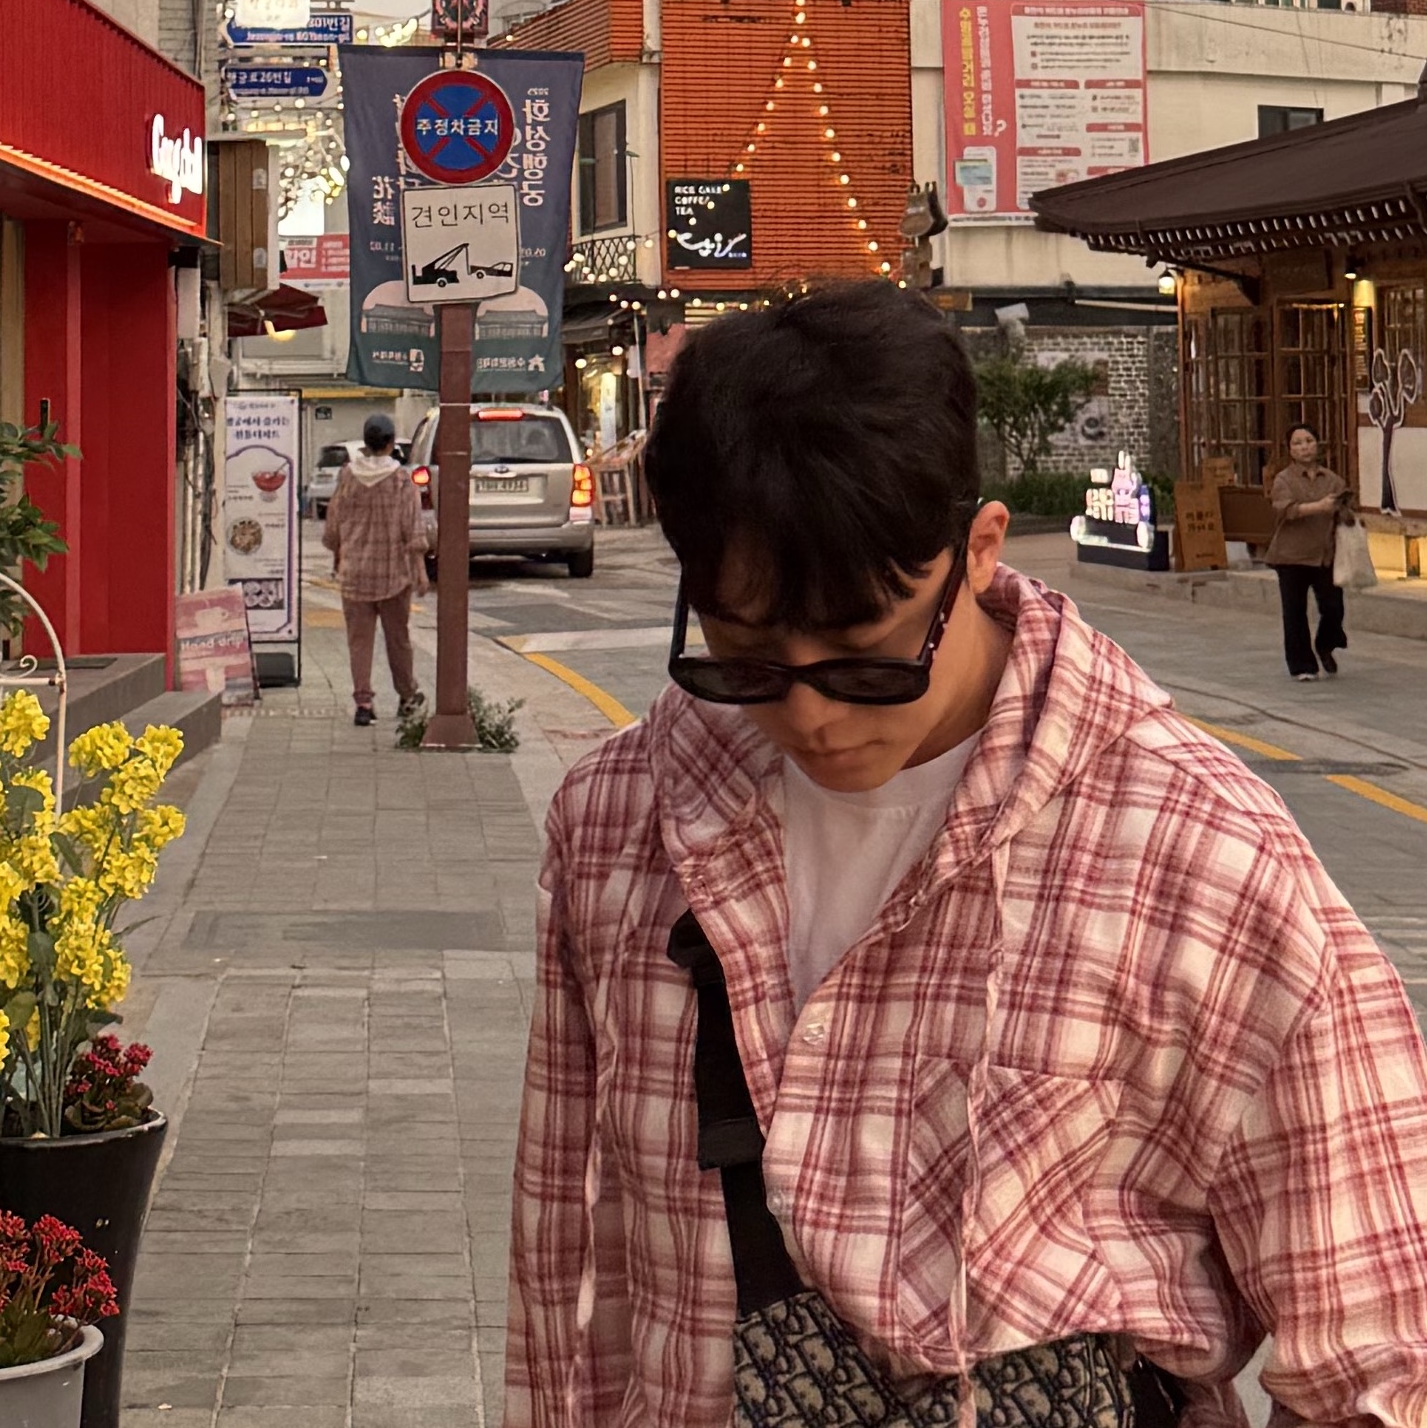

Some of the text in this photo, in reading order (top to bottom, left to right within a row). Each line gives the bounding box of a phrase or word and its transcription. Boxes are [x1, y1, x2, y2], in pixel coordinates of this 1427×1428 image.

[416, 118, 499, 136] 주정차금지
[411, 201, 509, 229] 견인지역
[675, 206, 694, 215] TEA
